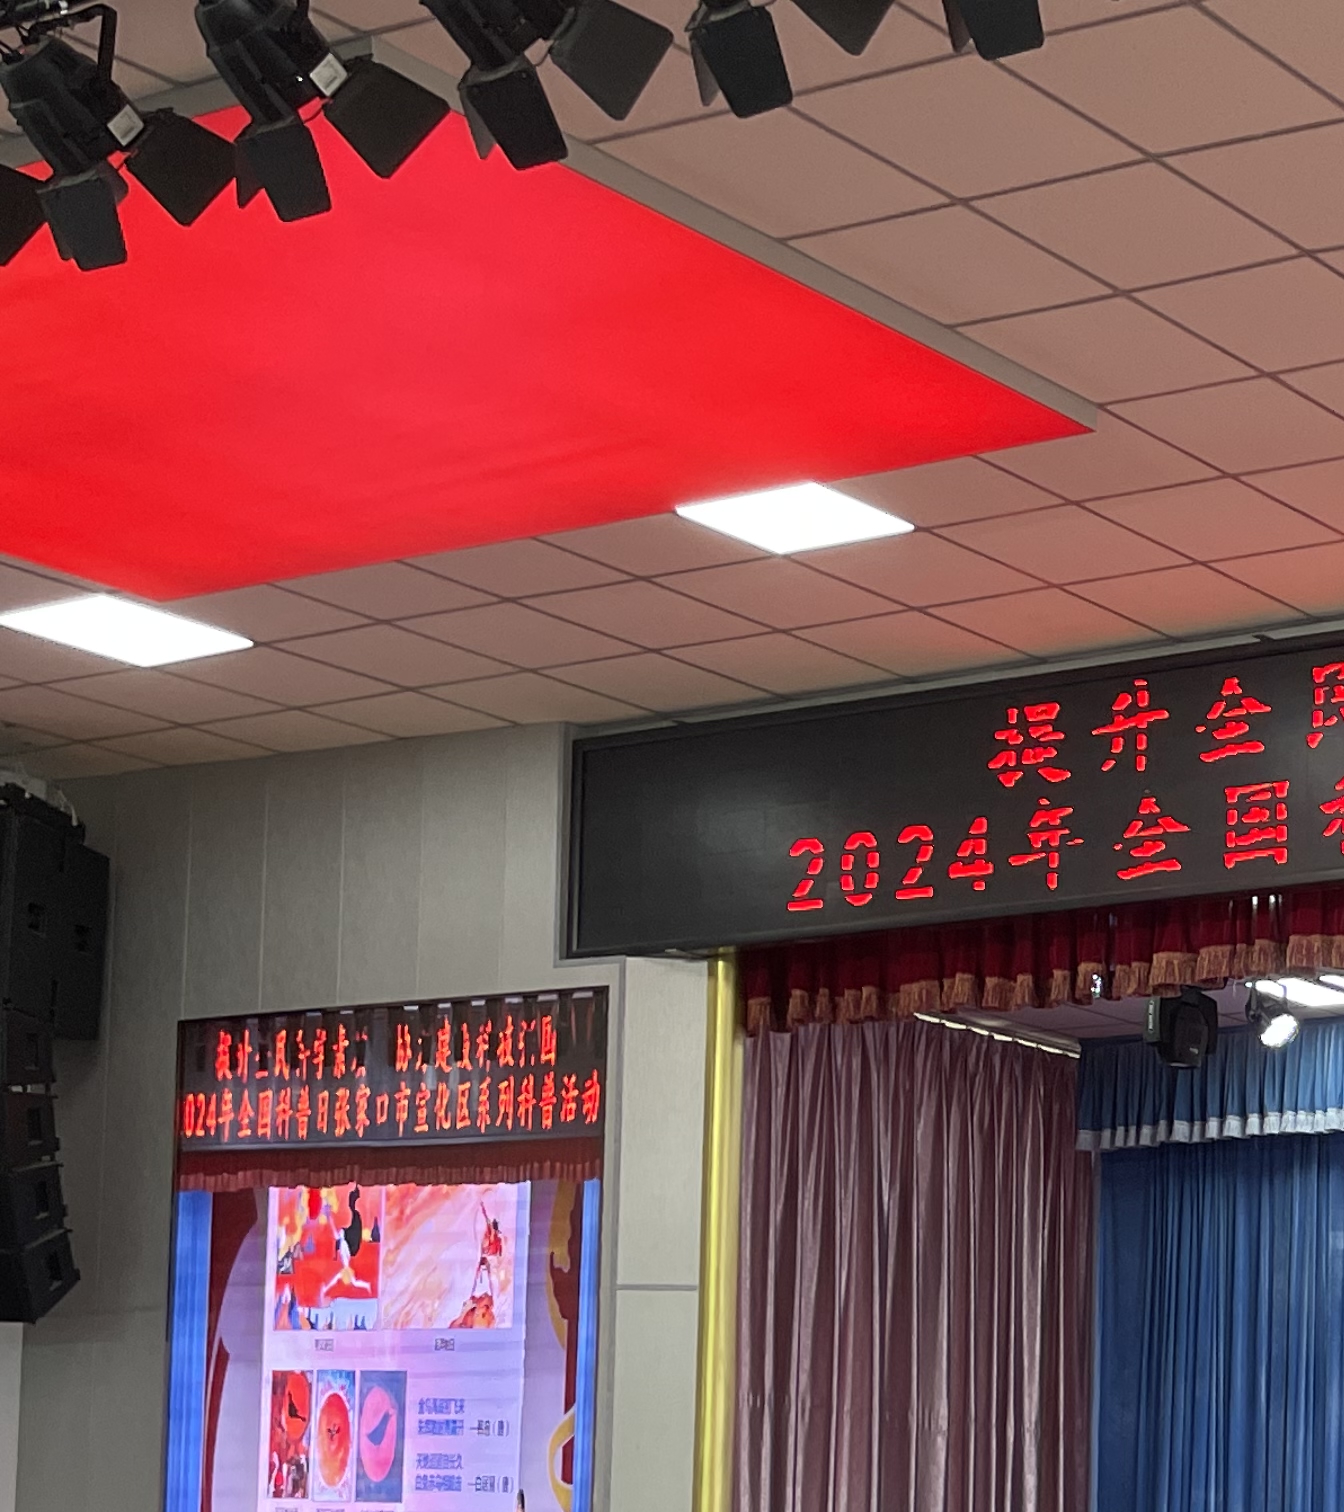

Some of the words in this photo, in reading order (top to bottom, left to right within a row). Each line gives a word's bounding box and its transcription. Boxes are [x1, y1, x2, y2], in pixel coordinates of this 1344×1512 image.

[183, 1068, 601, 1144] 024年全国科普日张家口市宣化区系列科普活动
